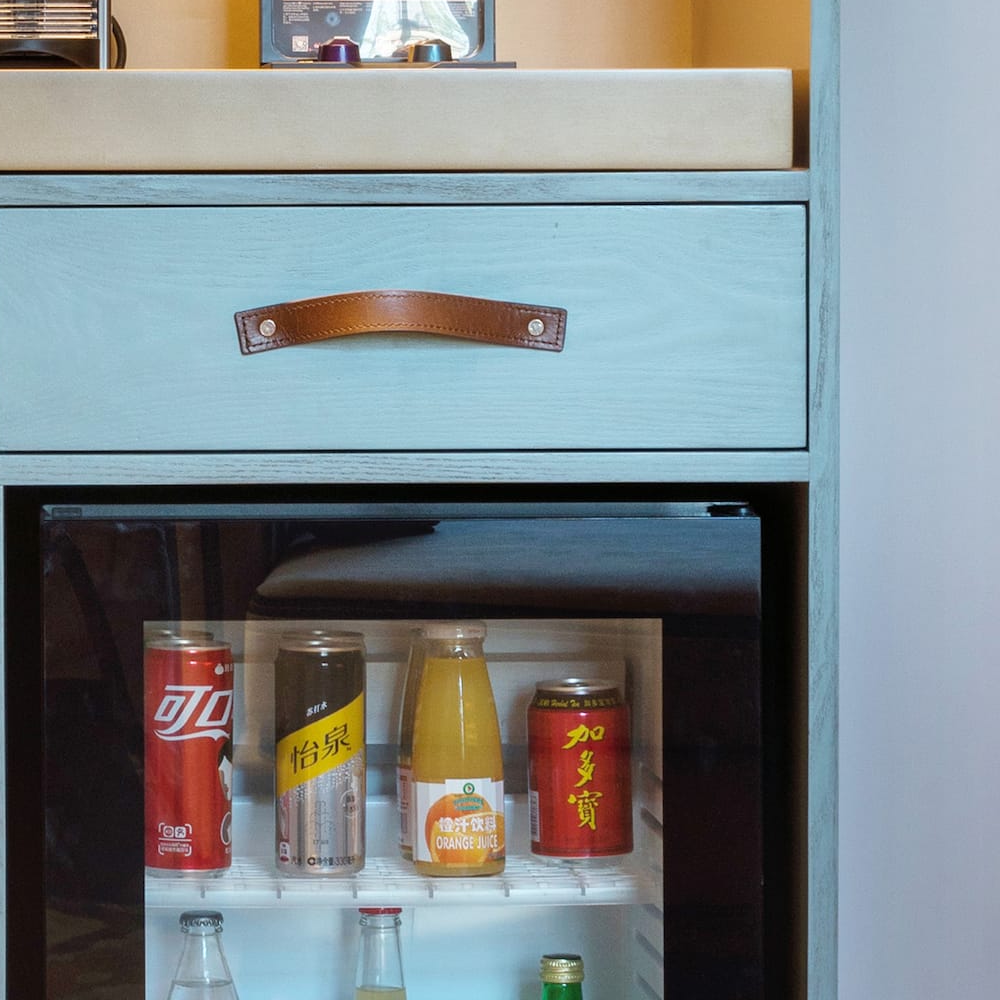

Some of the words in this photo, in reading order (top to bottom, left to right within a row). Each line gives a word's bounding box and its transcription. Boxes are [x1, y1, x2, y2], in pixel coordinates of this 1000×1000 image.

[290, 723, 350, 775] 怡泉
[436, 835, 475, 850] ORANGE
[477, 834, 499, 849] JUICE
